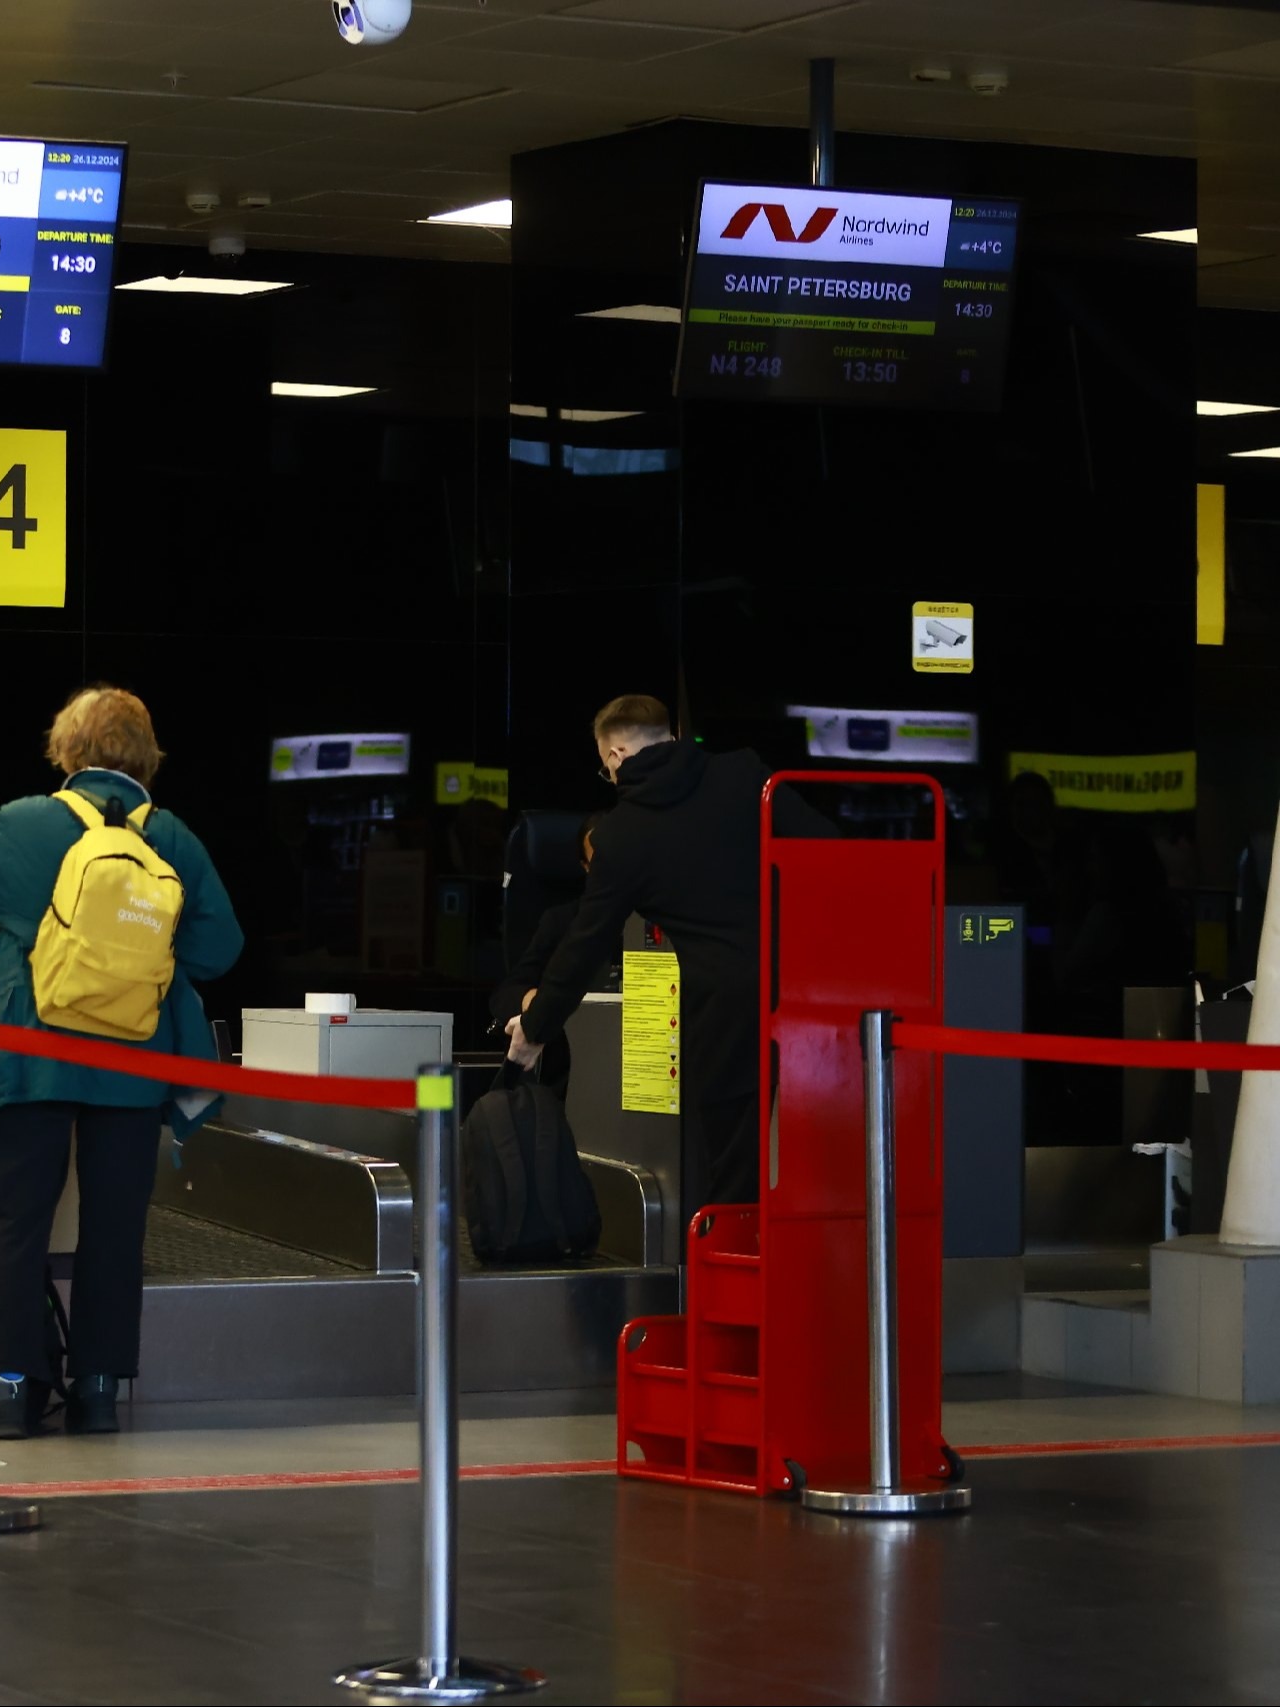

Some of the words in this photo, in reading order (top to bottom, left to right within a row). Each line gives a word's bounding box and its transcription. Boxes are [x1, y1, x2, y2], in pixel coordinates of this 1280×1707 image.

[48, 153, 71, 163] 12:20
[73, 155, 120, 166] 26.12.2024
[842, 215, 930, 237] Nordwind
[37, 231, 87, 243] DEPARTURE
[90, 232, 114, 244] TIME:
[839, 234, 874, 246] Airlines
[51, 255, 95, 273] 14:30
[724, 274, 783, 294] SAINT
[787, 277, 912, 302] PETERSBURG
[942, 279, 985, 291] DEPARTURE
[55, 305, 81, 315] GATE:
[954, 302, 992, 318] 14:30
[719, 312, 748, 324] Please
[749, 314, 771, 325] have
[773, 317, 791, 328] your
[793, 318, 832, 331] passport
[832, 320, 856, 332] ready
[857, 320, 869, 330] for
[871, 321, 908, 332] check-in
[60, 328, 71, 344] 8
[833, 346, 884, 358] CHECK-IN
[709, 354, 738, 375] N4
[744, 356, 782, 377] 248
[843, 361, 898, 383] 13:50
